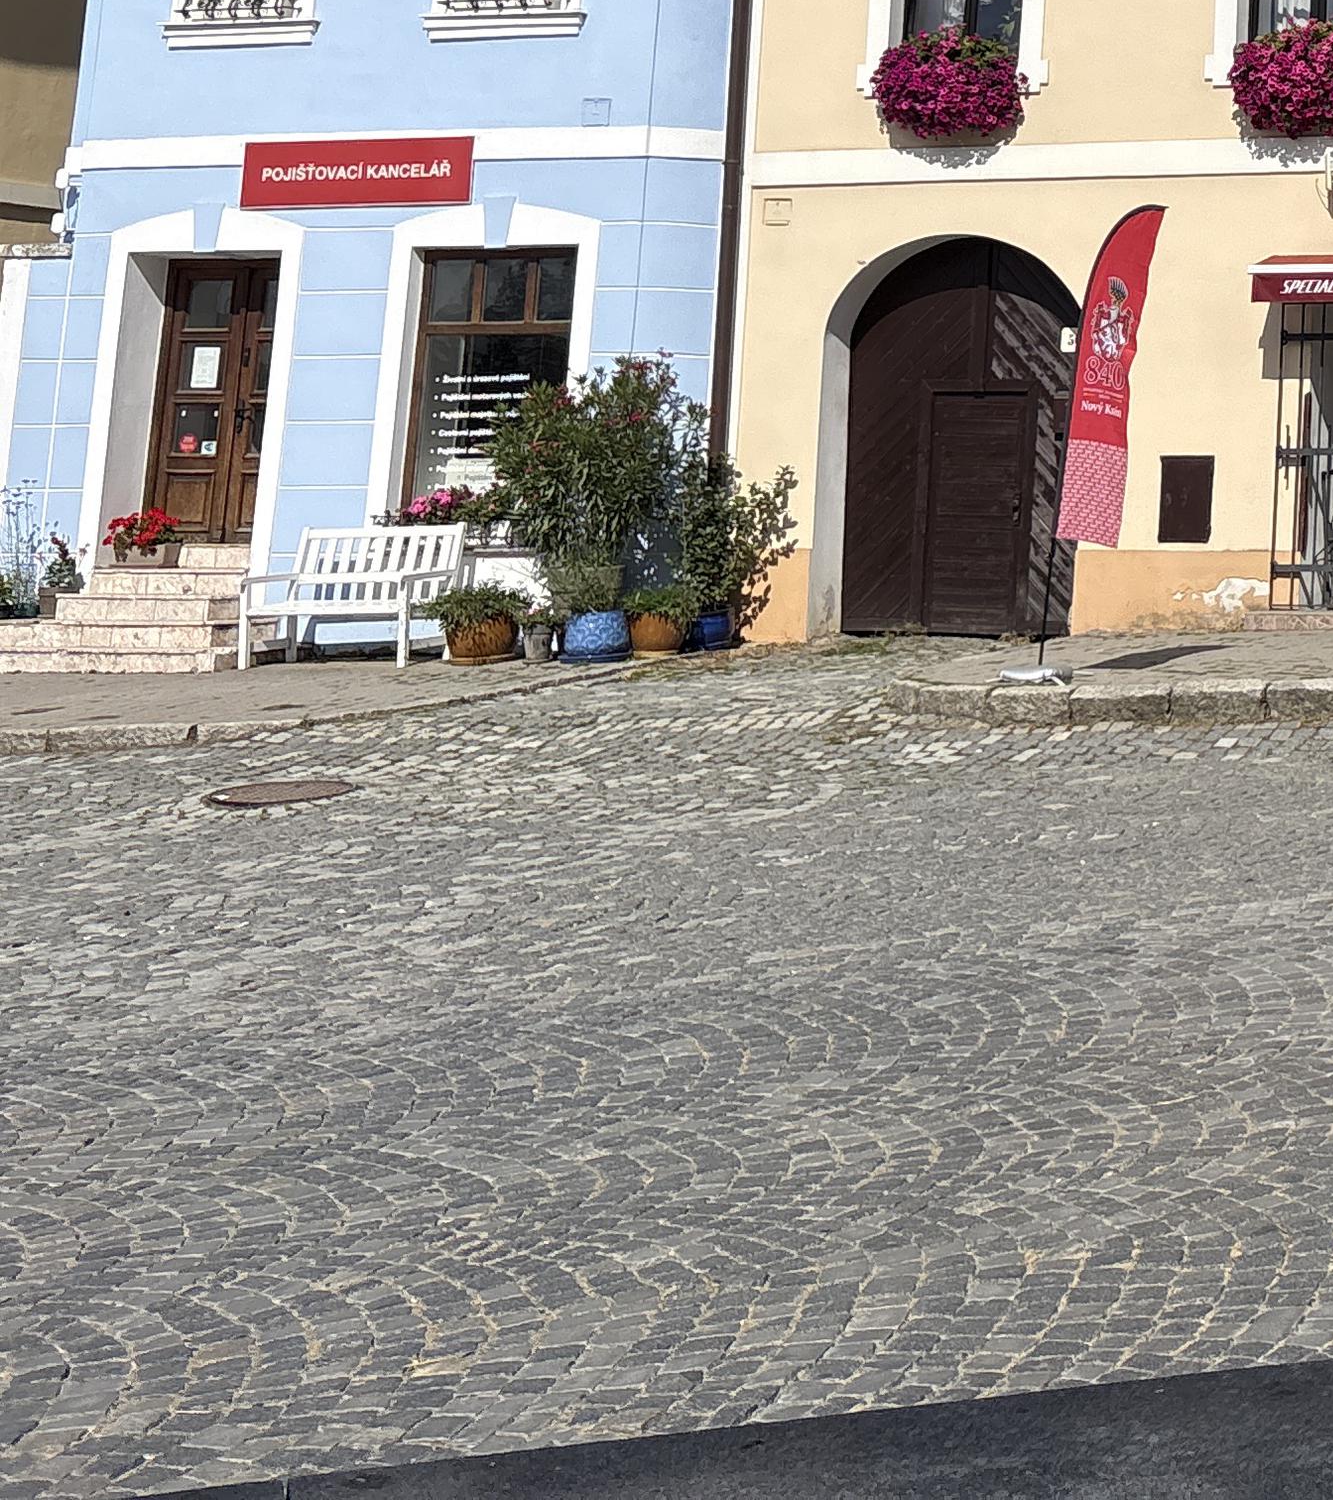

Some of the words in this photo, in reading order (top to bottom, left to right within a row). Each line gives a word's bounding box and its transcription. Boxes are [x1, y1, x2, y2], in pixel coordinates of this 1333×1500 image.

[261, 161, 364, 182] POJIŠŤOVACÍ
[366, 159, 451, 179] KANCELÁŘ
[1083, 355, 1126, 391] 840
